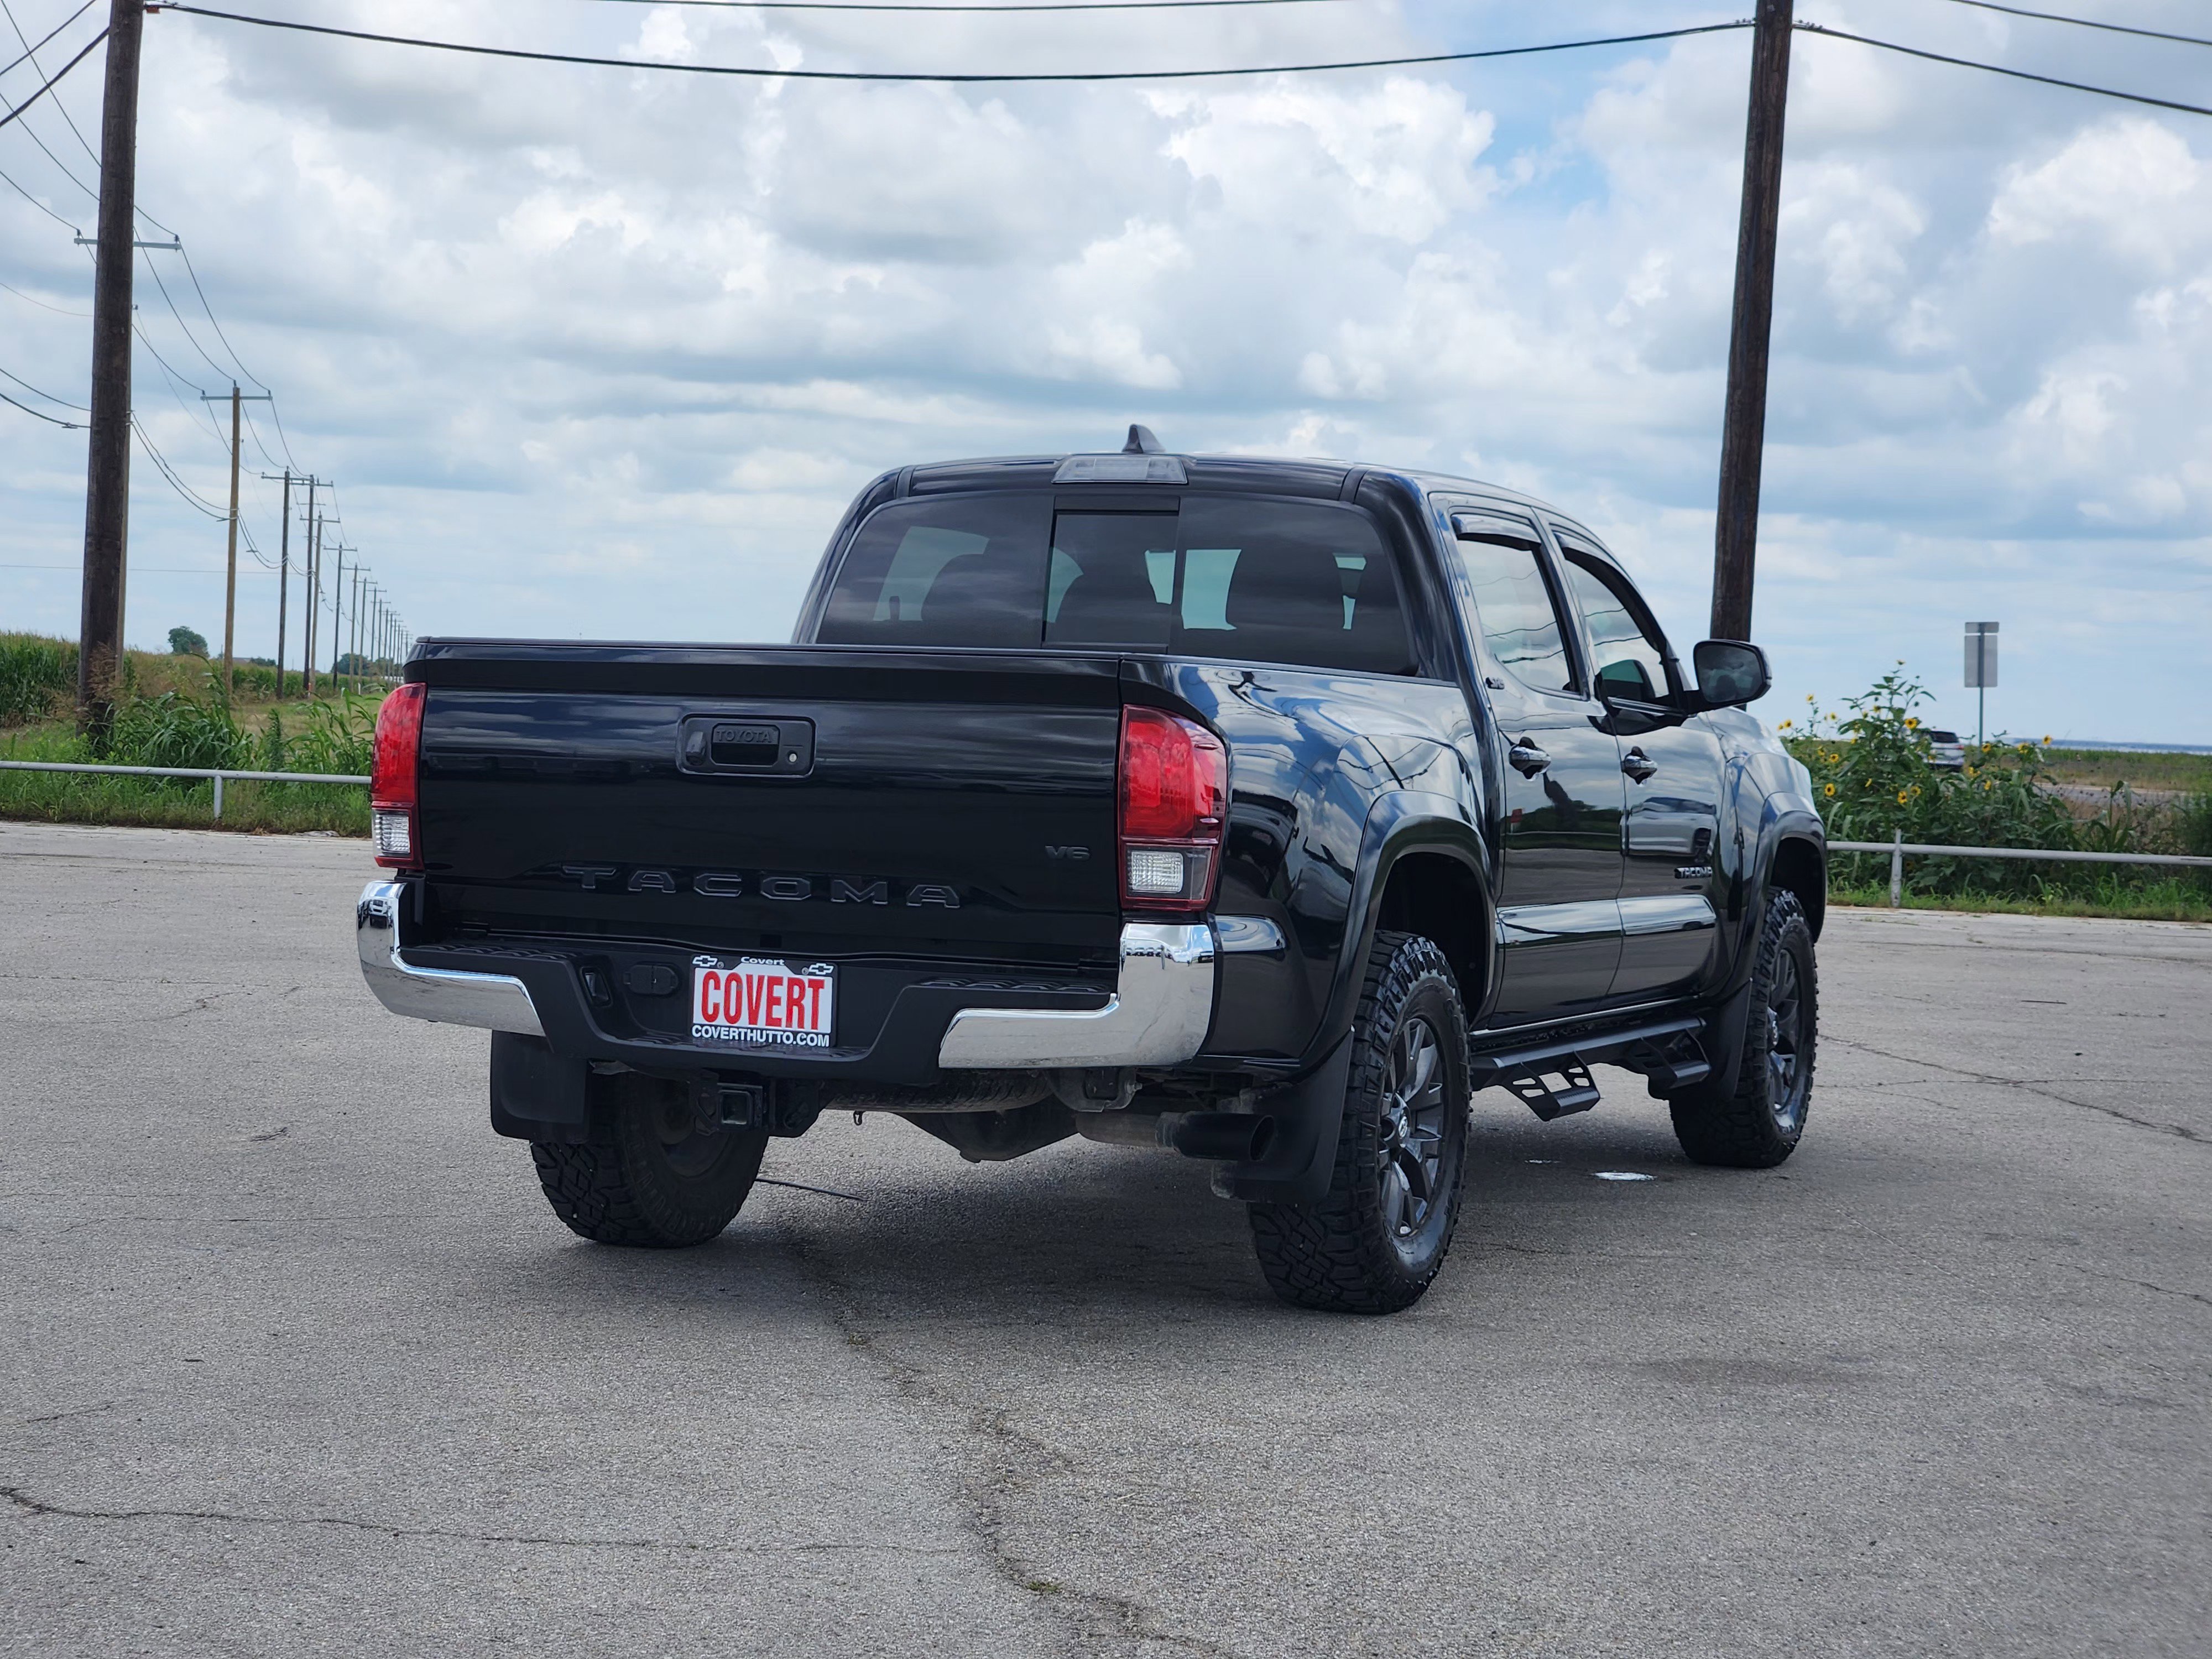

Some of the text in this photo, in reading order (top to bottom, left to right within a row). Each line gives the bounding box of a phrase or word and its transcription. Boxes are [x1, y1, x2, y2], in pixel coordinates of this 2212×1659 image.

[717, 730, 772, 743] TOYOTA
[1045, 846, 1089, 861] V6
[562, 865, 960, 908] TACOMA
[740, 957, 785, 966] Covert
[701, 971, 825, 1030] COVERT
[692, 1025, 830, 1047] COVERTHUTTO.COM
